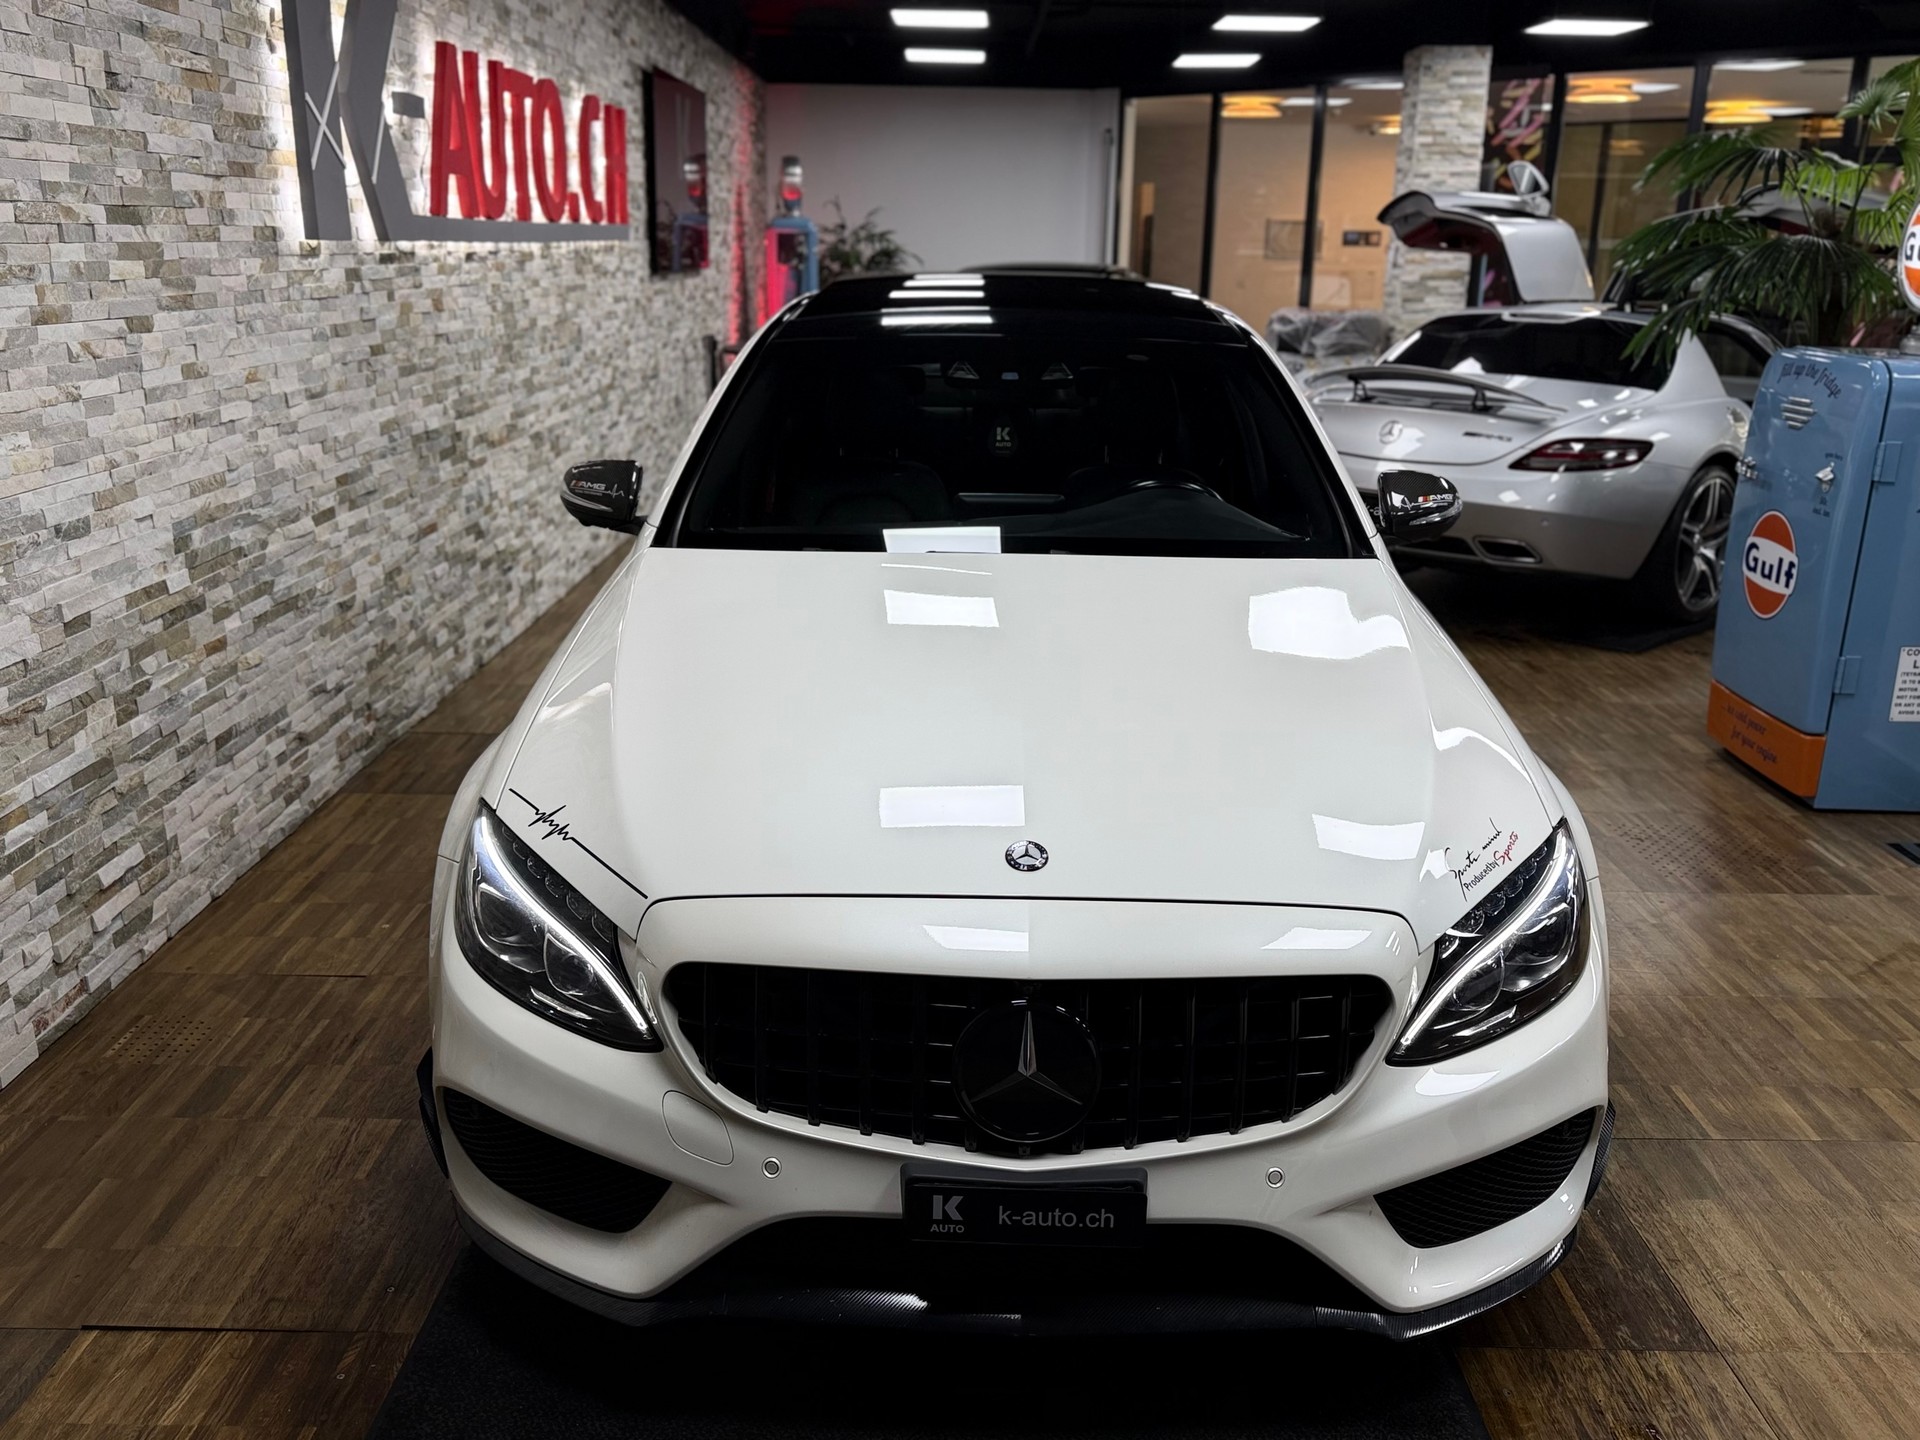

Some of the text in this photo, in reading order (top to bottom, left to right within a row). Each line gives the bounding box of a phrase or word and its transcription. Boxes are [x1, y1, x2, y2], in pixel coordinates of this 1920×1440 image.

[1904, 231, 1920, 261] G
[578, 480, 606, 491] AMG
[1428, 493, 1454, 501] AMG
[1745, 542, 1796, 589] Gulf
[1493, 831, 1519, 865] Sports
[932, 1194, 1115, 1229] K k-auto.ch
[930, 1224, 965, 1233] AUTO
